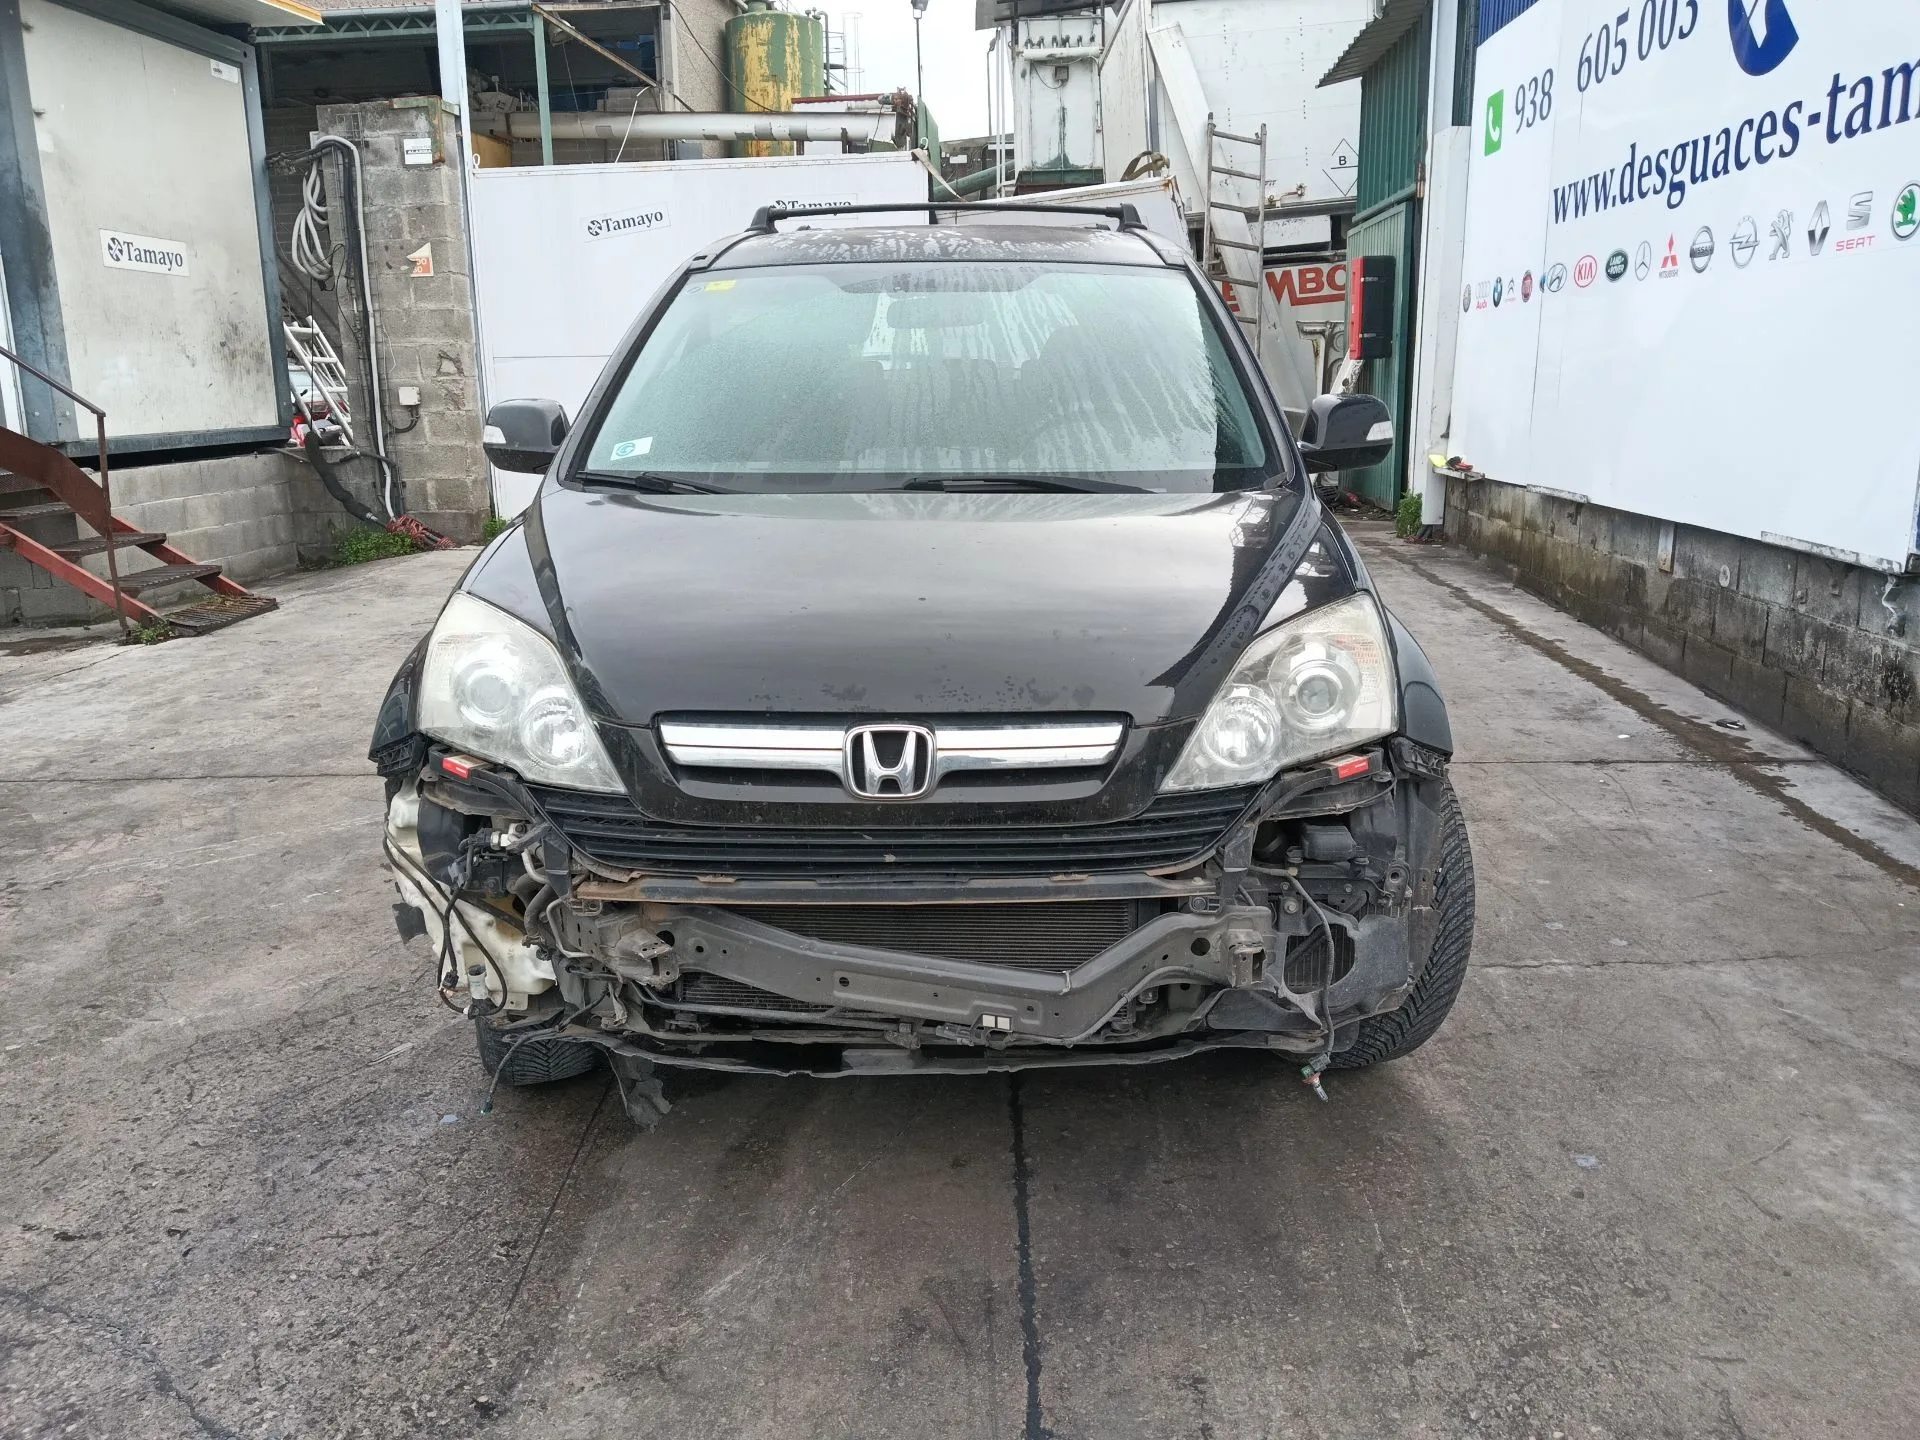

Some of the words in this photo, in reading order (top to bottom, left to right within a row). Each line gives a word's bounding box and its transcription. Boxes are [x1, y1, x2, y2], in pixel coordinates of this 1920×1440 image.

[1515, 68, 1554, 134] 938
[1577, 7, 1630, 93] 605
[1339, 156, 1347, 166] B
[602, 211, 664, 232] Tamayo
[1835, 235, 1876, 252] SEAT
[123, 241, 183, 272] Tamayo
[1577, 261, 1593, 281] KIA
